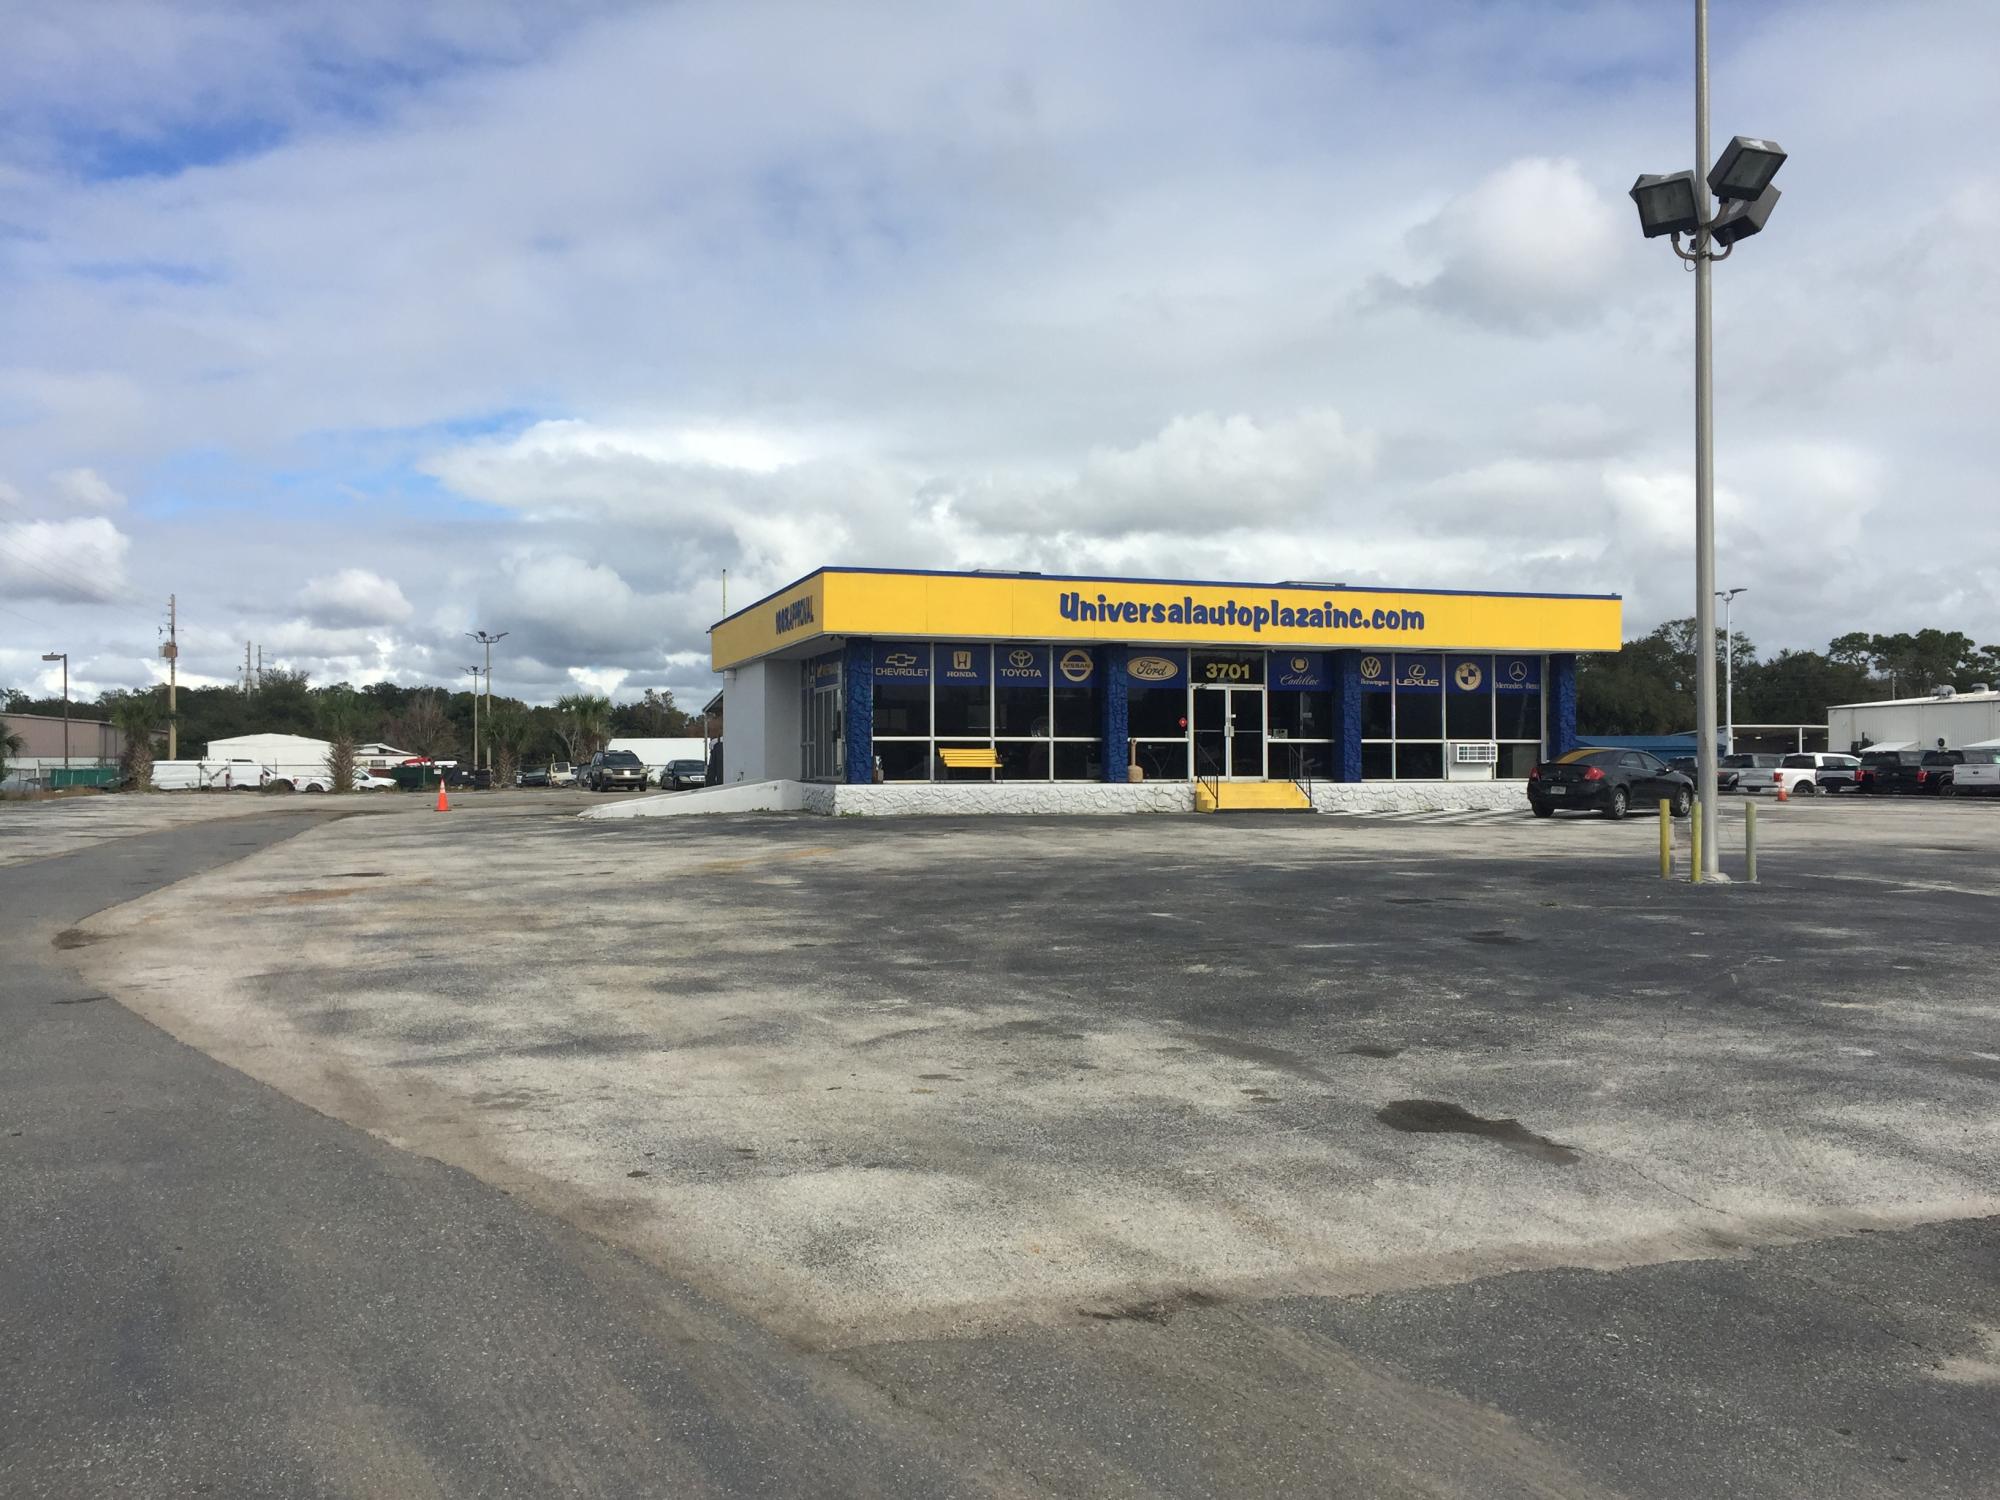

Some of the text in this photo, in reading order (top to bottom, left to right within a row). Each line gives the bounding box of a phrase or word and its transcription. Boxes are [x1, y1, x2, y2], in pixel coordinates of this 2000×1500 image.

[1060, 592, 1424, 631] Universalautoplazainc.com
[875, 667, 929, 677] CHEVROLET
[1000, 668, 1042, 677] TOYOTA
[1136, 660, 1168, 676] Ford
[1206, 663, 1250, 679] 3701
[1279, 673, 1320, 686] Cadillac
[1396, 678, 1440, 687] LEXUS
